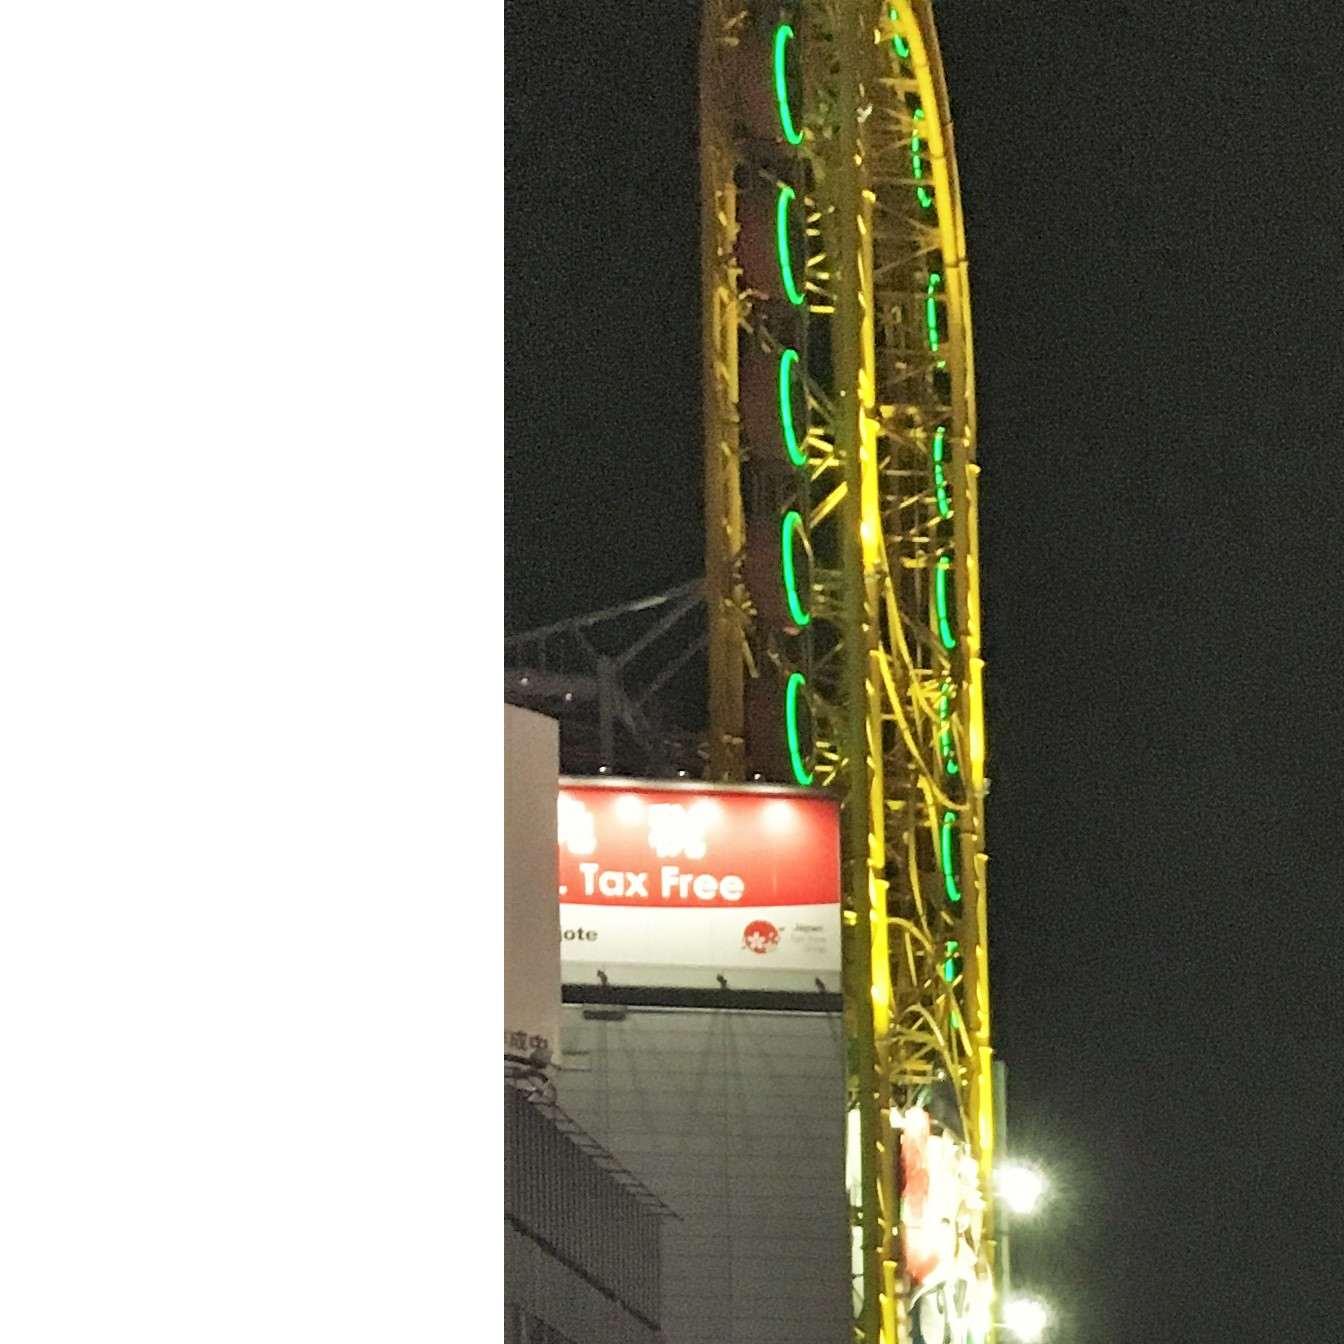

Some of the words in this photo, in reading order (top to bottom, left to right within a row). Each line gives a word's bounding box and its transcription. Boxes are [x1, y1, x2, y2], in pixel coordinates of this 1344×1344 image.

[579, 861, 648, 898] Tax
[661, 865, 746, 903] Free
[560, 925, 599, 944] ote
